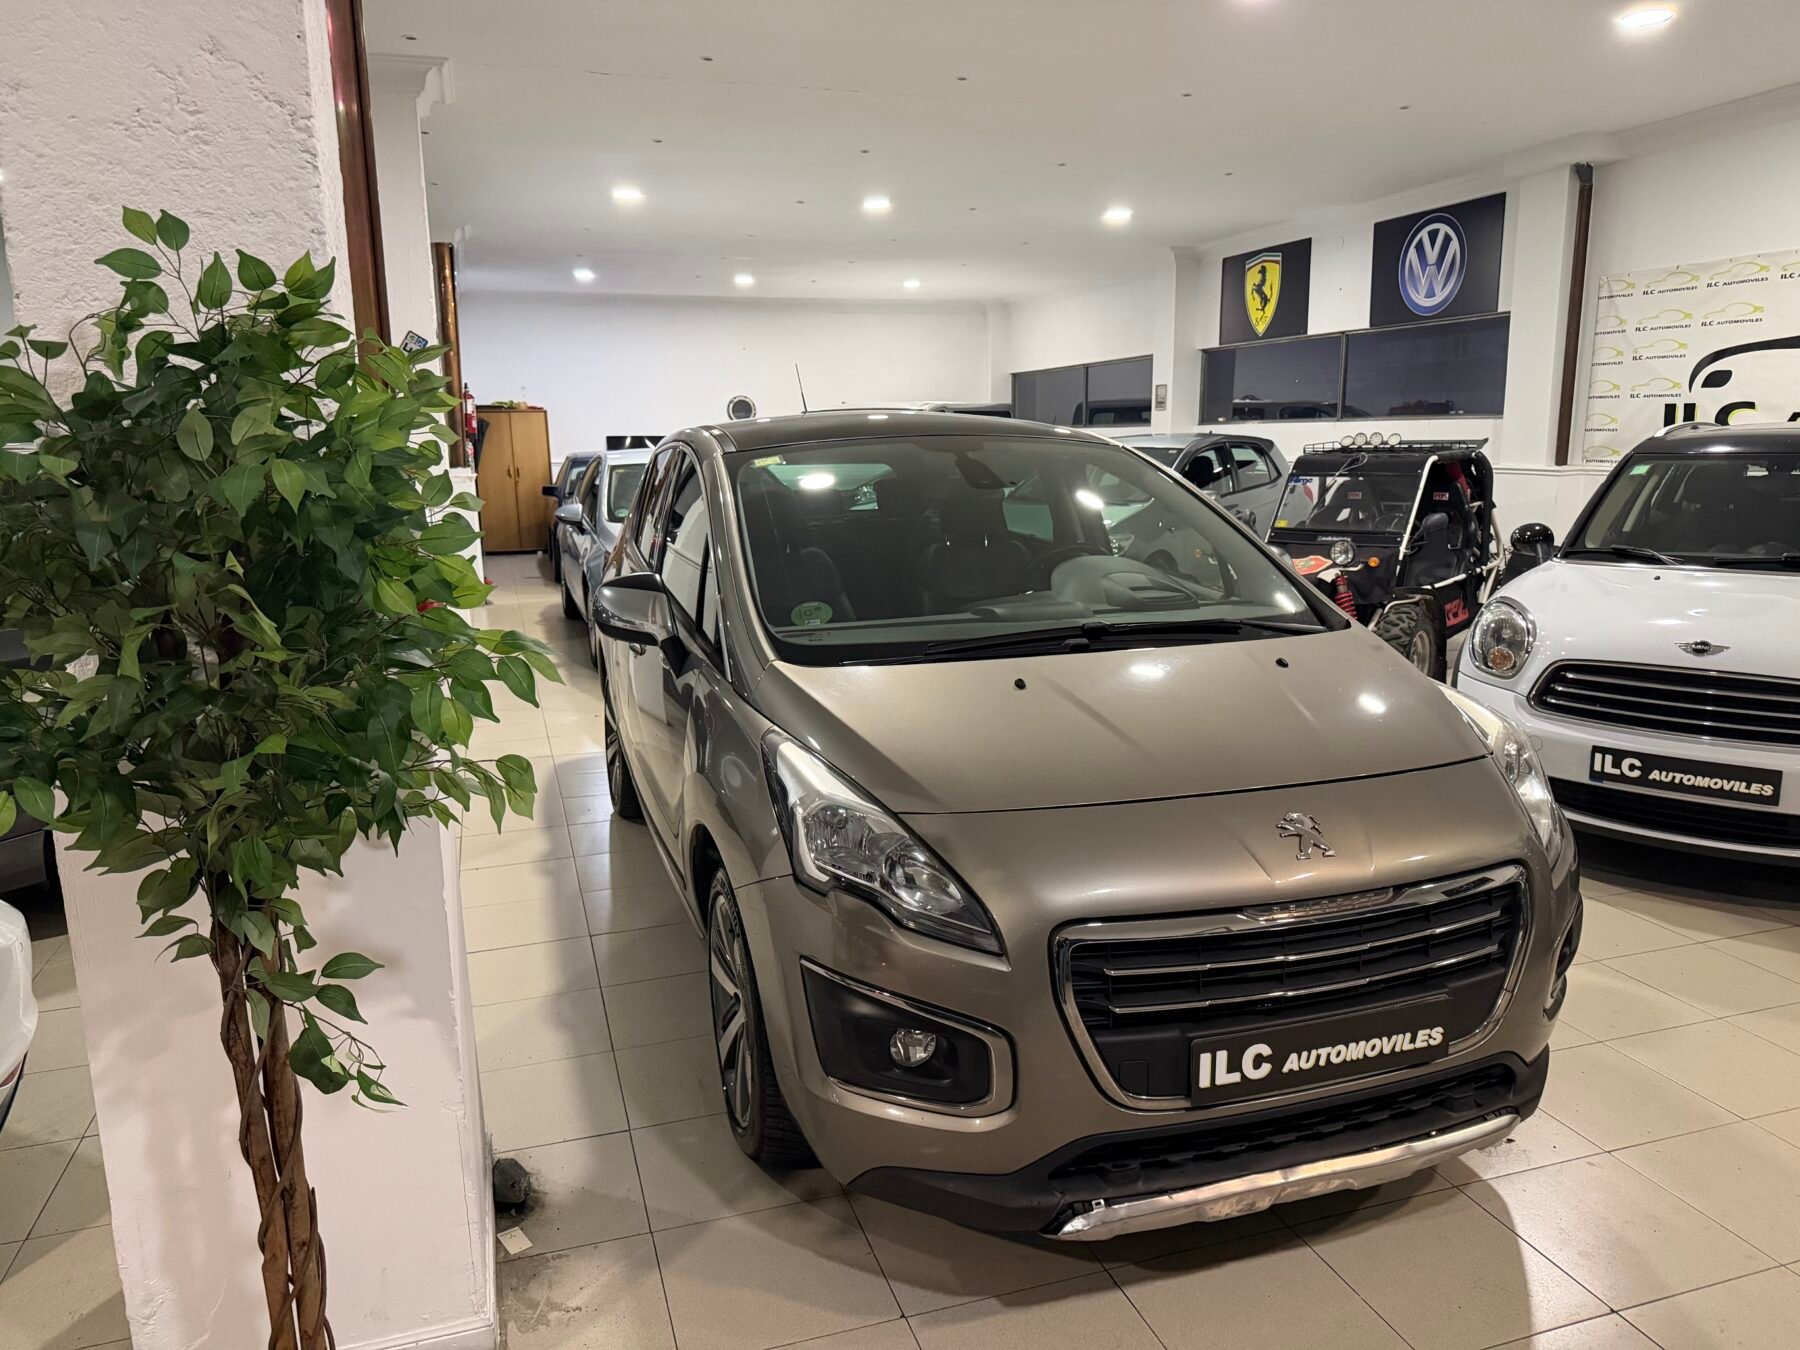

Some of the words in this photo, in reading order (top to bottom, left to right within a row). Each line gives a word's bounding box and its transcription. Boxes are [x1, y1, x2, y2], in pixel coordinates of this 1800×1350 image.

[1722, 277, 1768, 287] AUTOMOVILES
[1657, 286, 1698, 294] AUTOMOVILES
[1716, 318, 1763, 326] AUTOMOVILES
[1593, 752, 1643, 777] ILC
[1648, 769, 1775, 796] AUTOMOVILES
[1198, 1043, 1273, 1089] ILC
[1282, 1026, 1445, 1074] AUTOMOVILES
